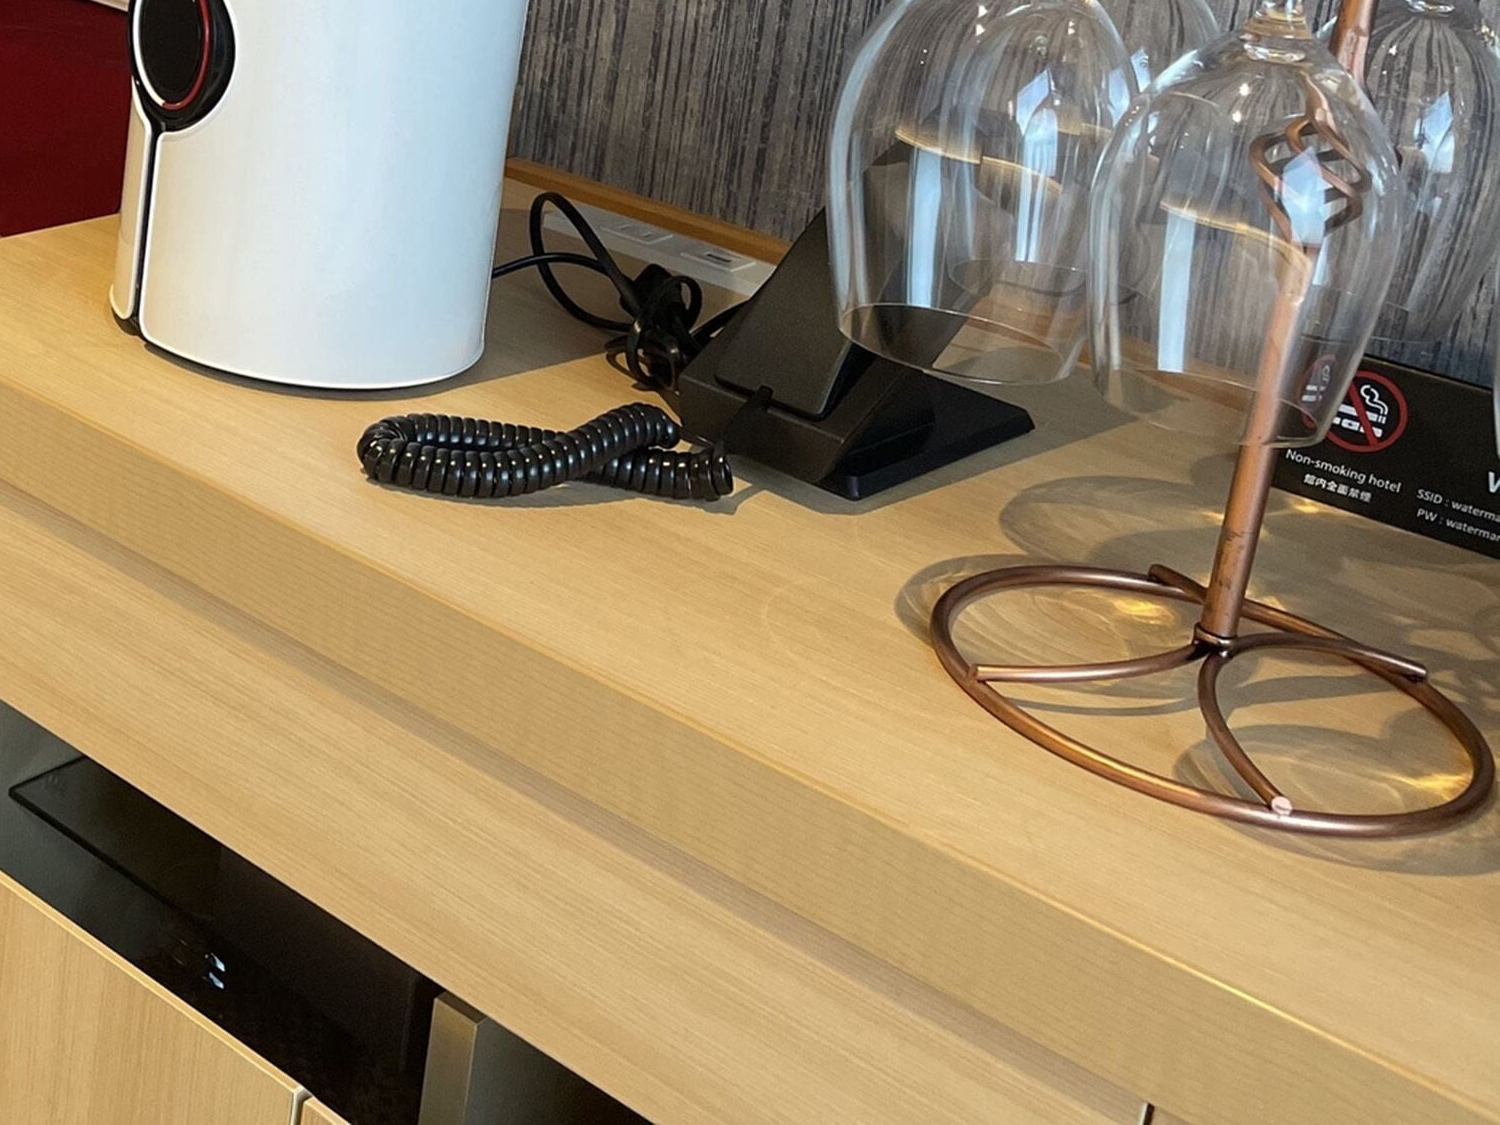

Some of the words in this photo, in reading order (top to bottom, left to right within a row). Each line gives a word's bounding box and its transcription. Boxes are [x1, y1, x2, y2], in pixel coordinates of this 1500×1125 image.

[1285, 448, 1366, 485] Non-smoking
[1368, 474, 1402, 494] hotel
[1303, 473, 1372, 503] 館内全面禁煙
[1416, 489, 1443, 504] SSID
[1416, 507, 1438, 522] PW
